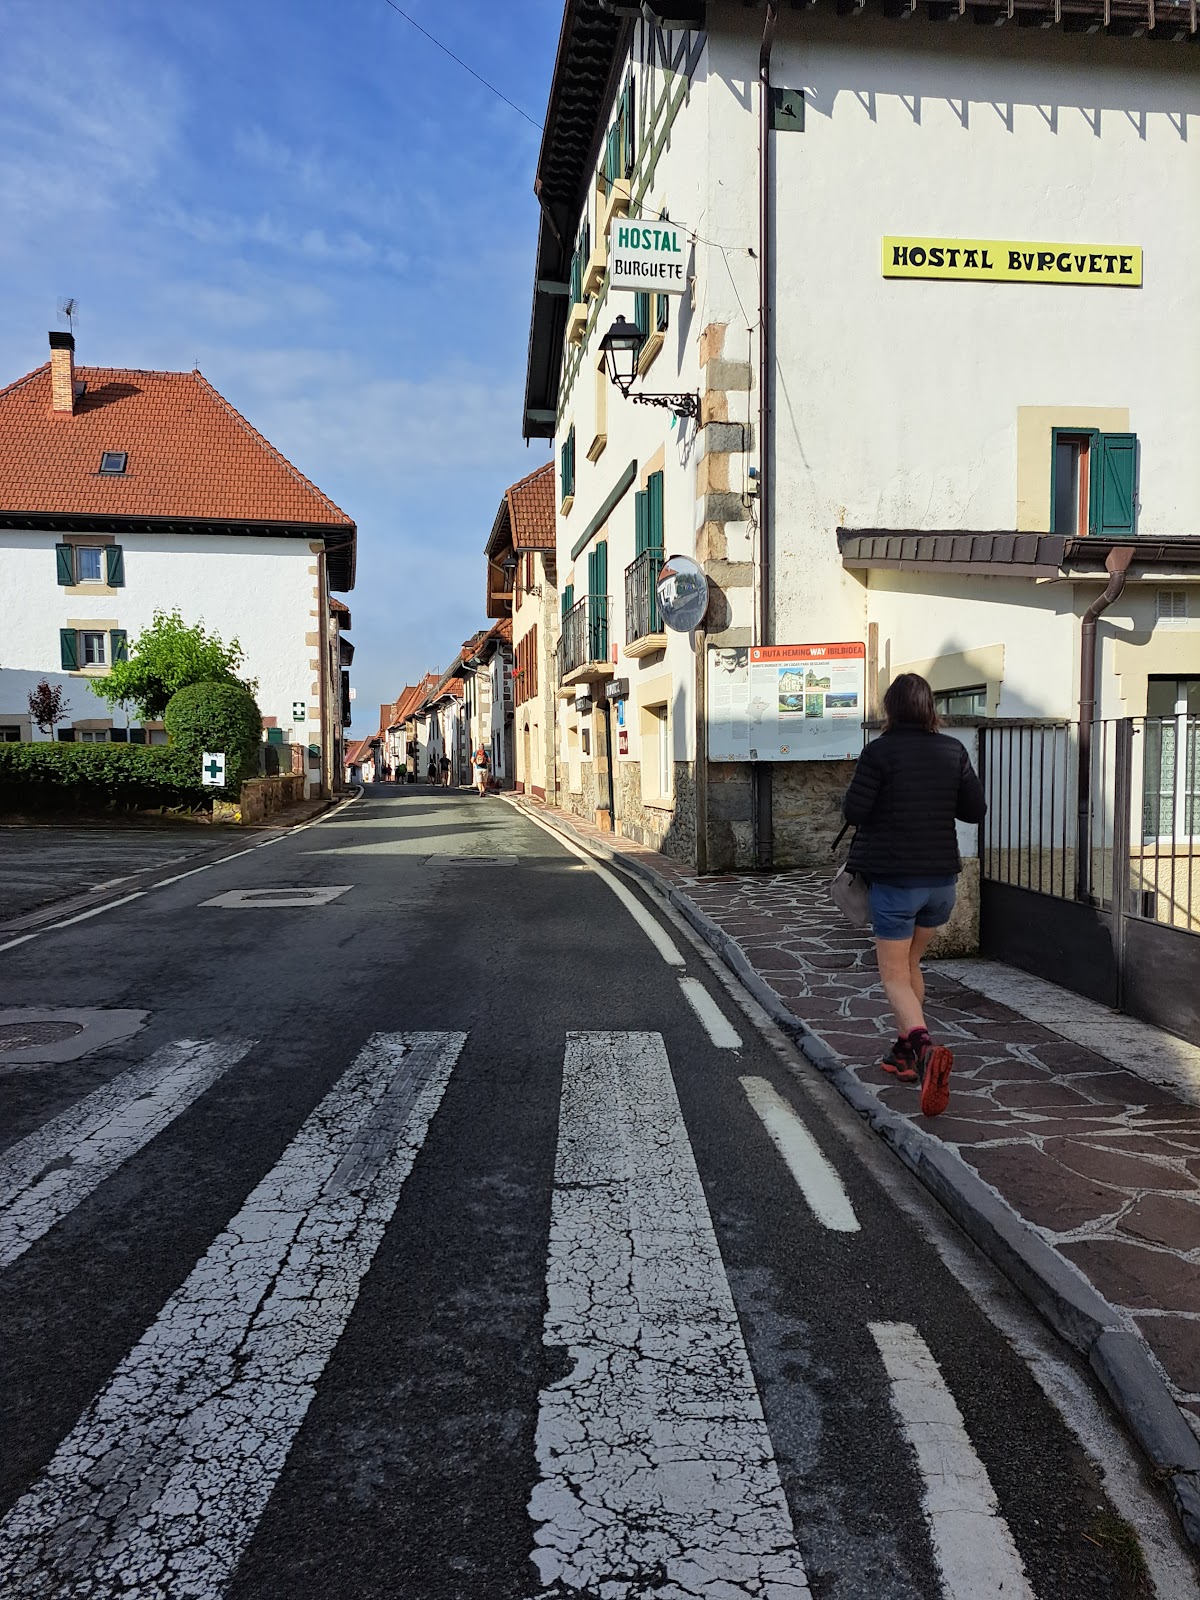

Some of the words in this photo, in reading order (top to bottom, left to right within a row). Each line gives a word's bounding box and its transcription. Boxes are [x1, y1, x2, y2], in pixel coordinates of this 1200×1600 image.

[618, 227, 682, 253] HOSTAL
[892, 246, 994, 269] HOSTAL
[614, 259, 684, 280] BURGUETE
[762, 648, 781, 657] RUTA
[782, 647, 827, 657] HEMINGWAY
[827, 646, 863, 655] IBILBIDEA
